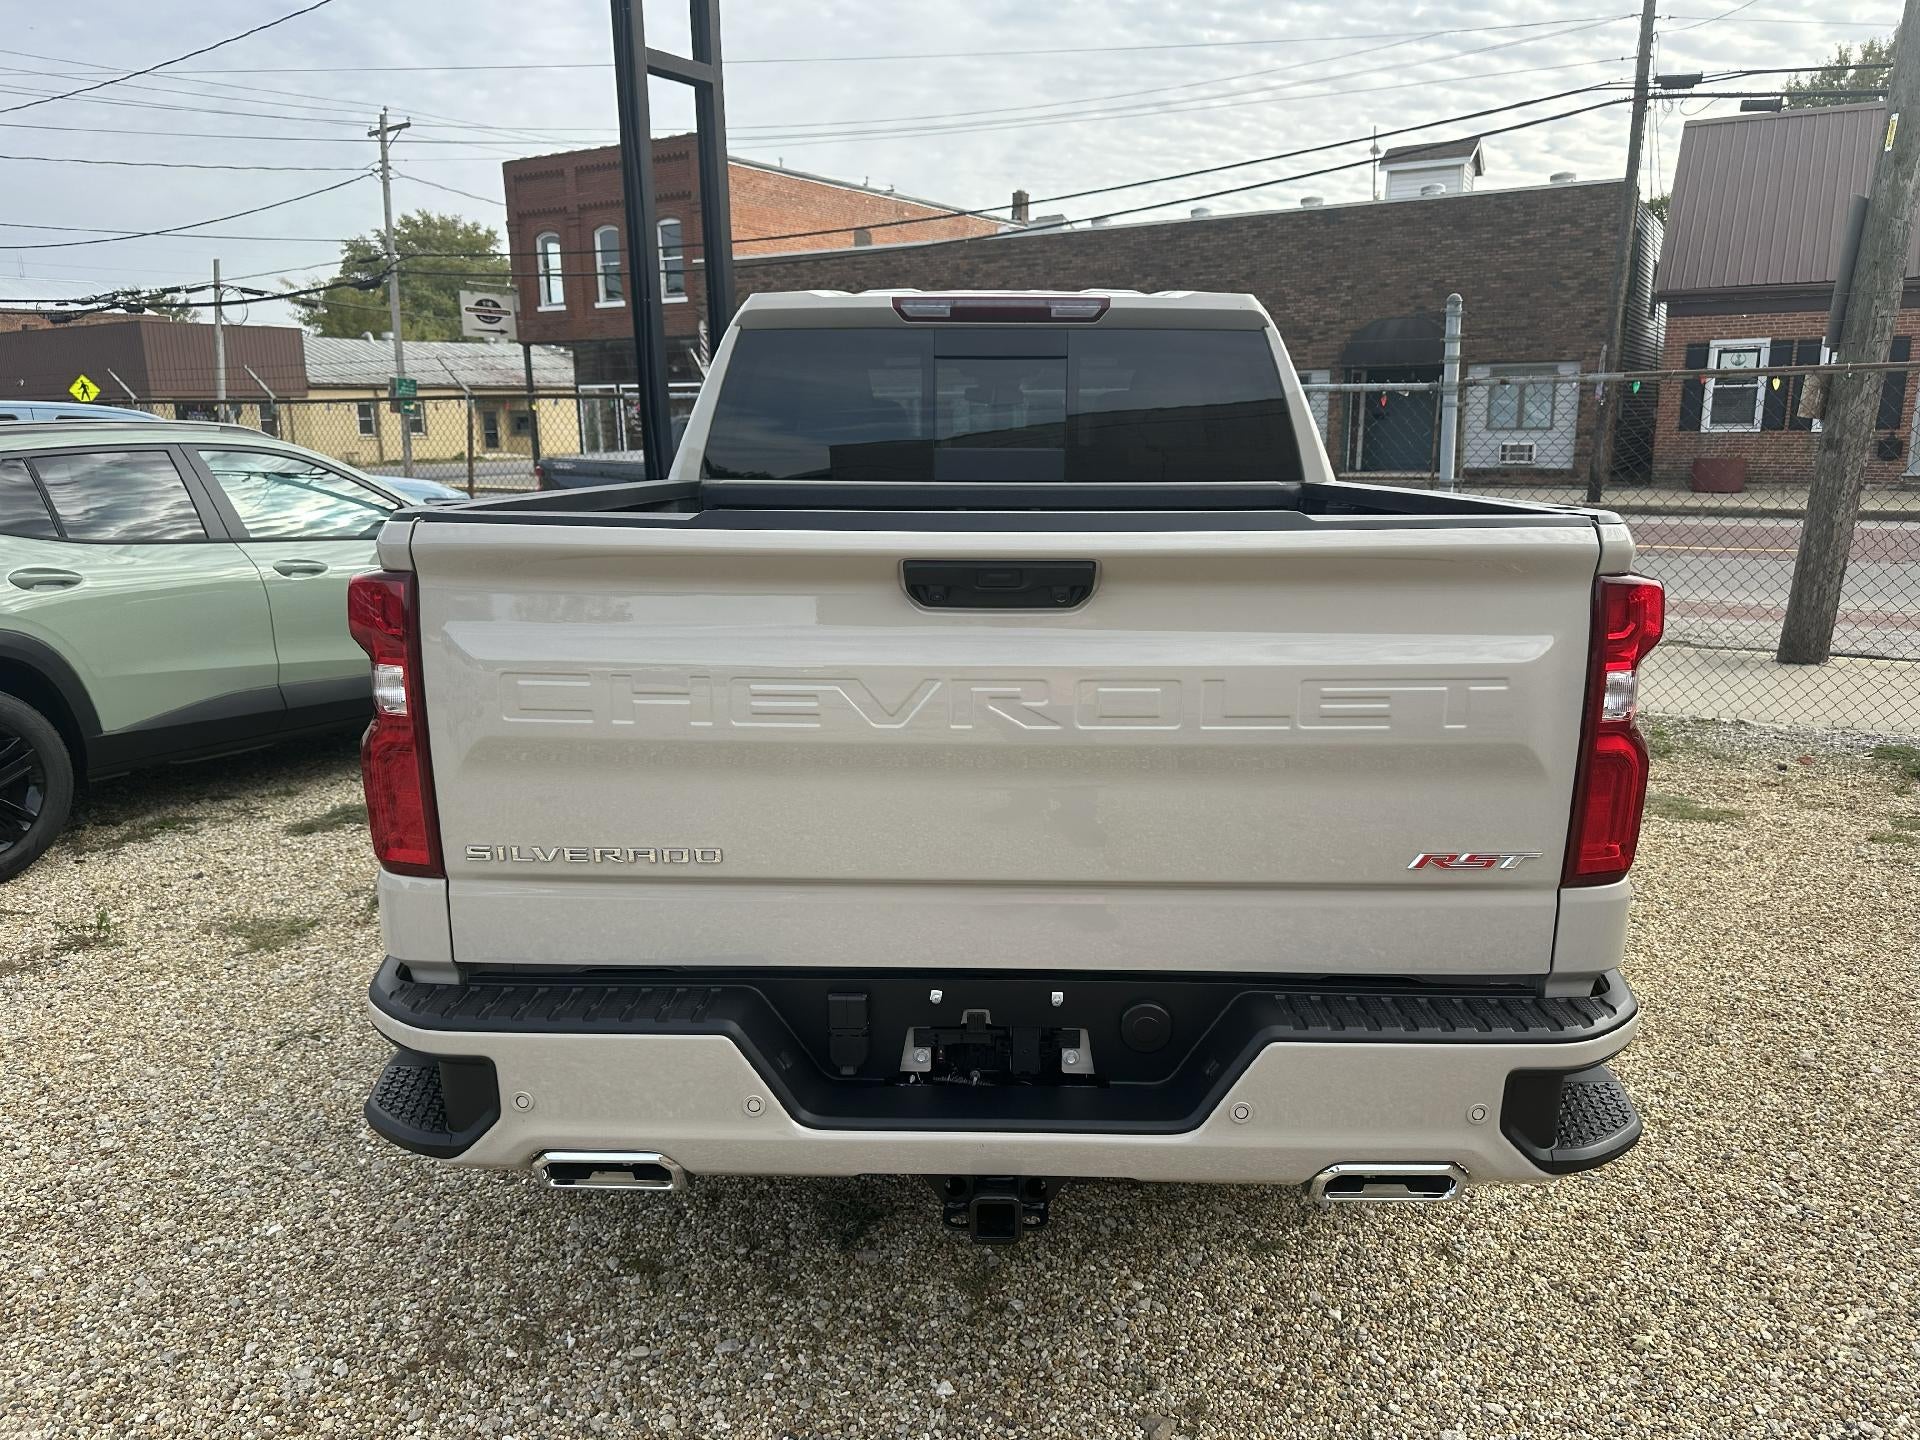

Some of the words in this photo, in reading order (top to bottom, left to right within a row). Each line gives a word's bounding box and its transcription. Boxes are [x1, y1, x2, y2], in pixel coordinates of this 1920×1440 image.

[499, 671, 1510, 730] CHEVROLET
[465, 845, 724, 864] SILVERADO
[1406, 852, 1544, 870] RST
